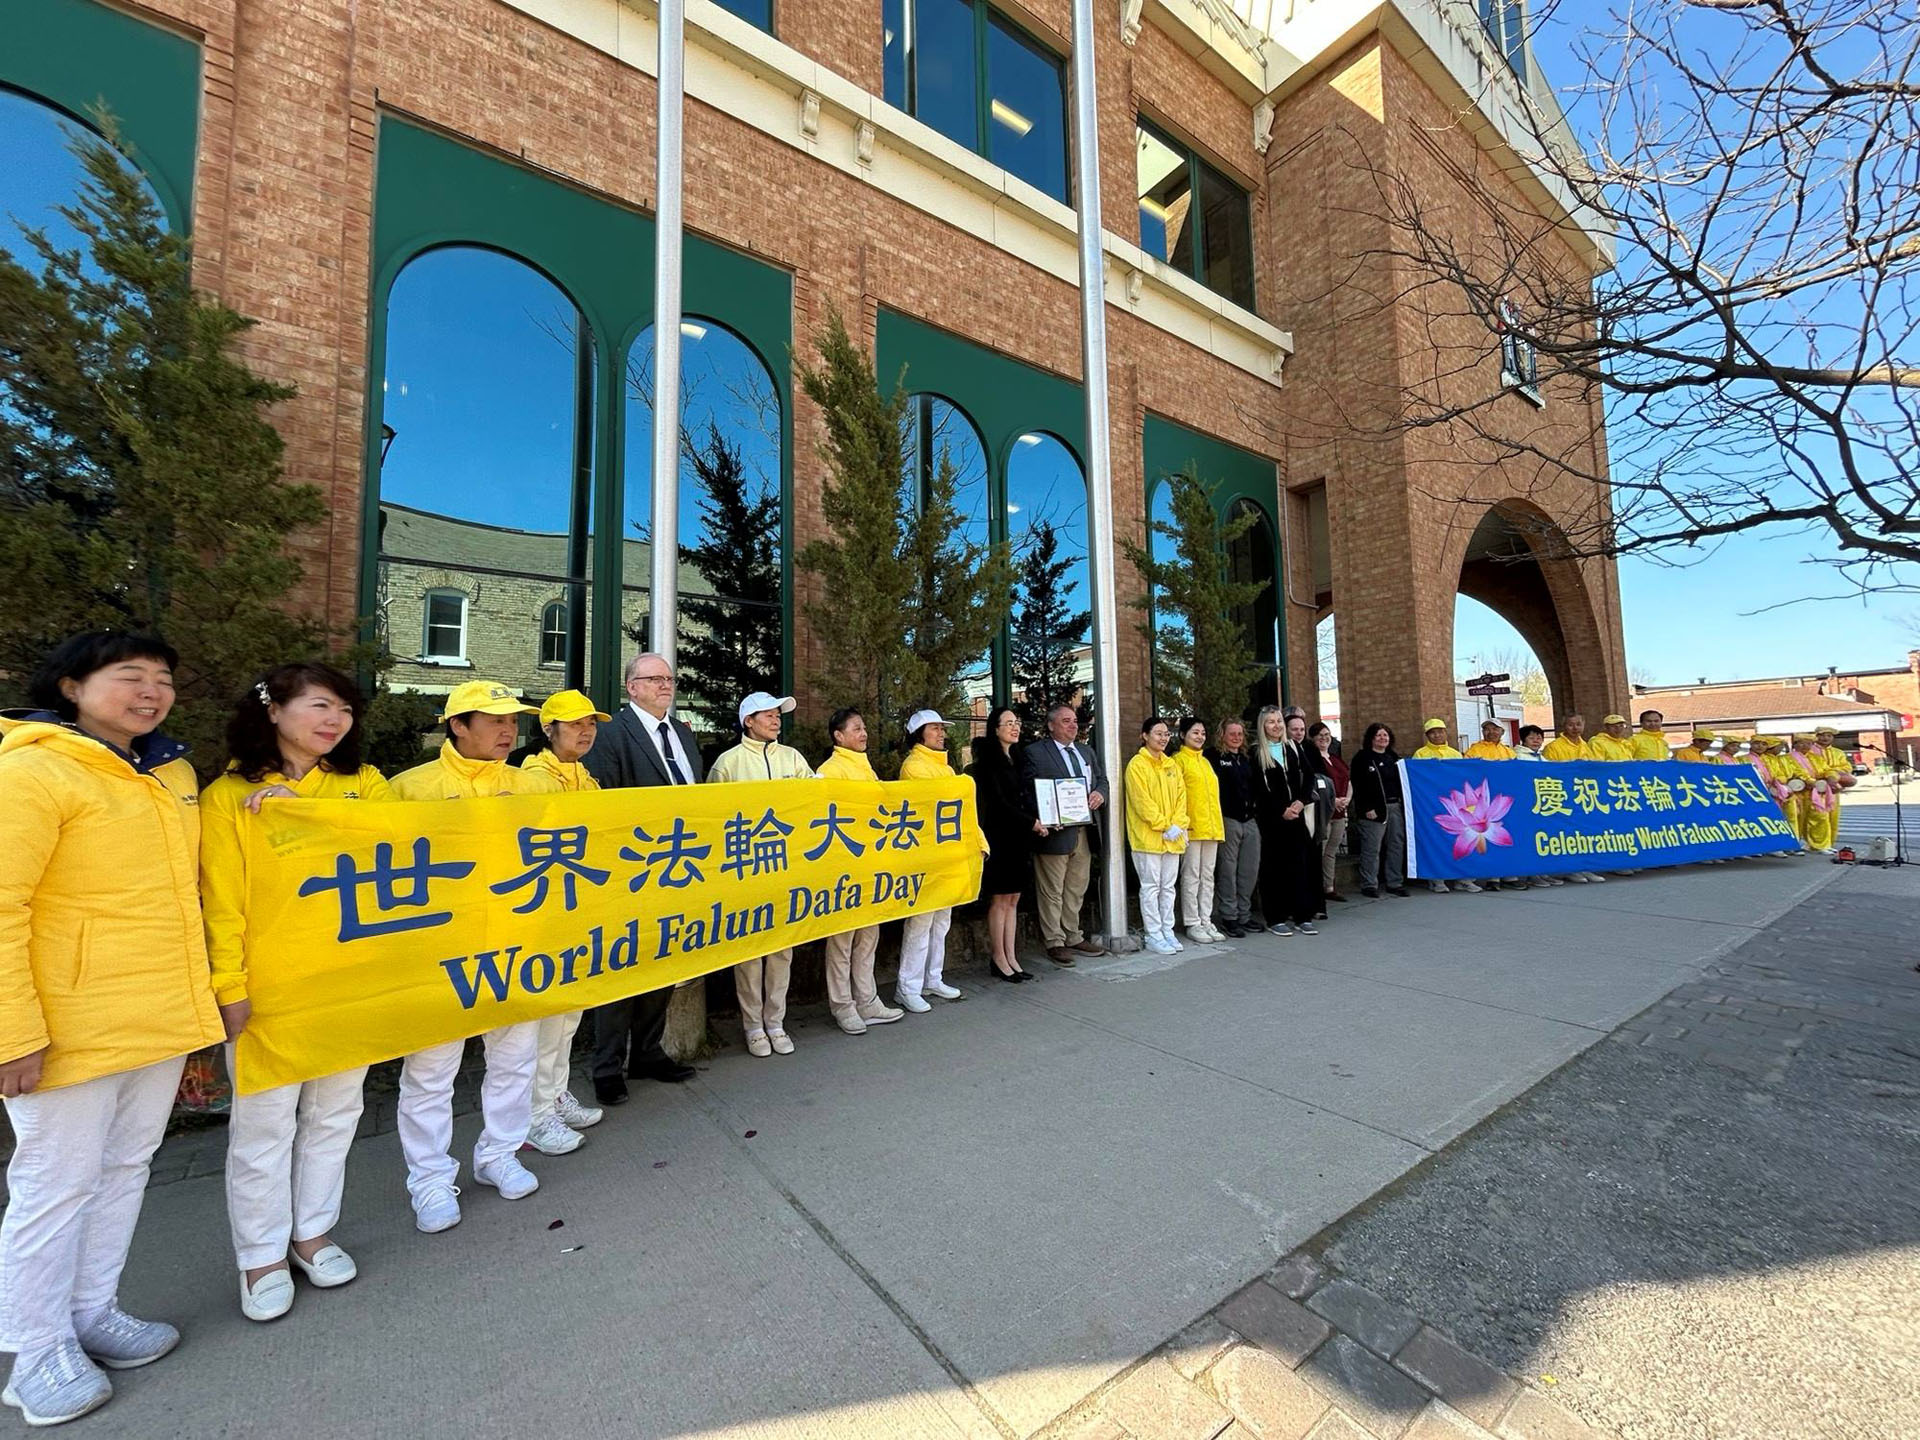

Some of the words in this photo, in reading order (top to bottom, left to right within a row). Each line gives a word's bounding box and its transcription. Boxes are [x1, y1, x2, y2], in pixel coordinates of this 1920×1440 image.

[1531, 775, 1770, 817] 慶祝法輪大法日
[1535, 831, 1638, 856] Celebrating
[1635, 824, 1680, 850] World
[1677, 823, 1722, 845] Falun
[1719, 818, 1766, 841] Dafa
[1757, 816, 1795, 838] Day
[299, 799, 964, 943] 世界法輪大法日
[440, 917, 640, 1010] World
[654, 902, 775, 960] Falun
[786, 874, 862, 926] Dafa
[872, 871, 926, 907] Day
